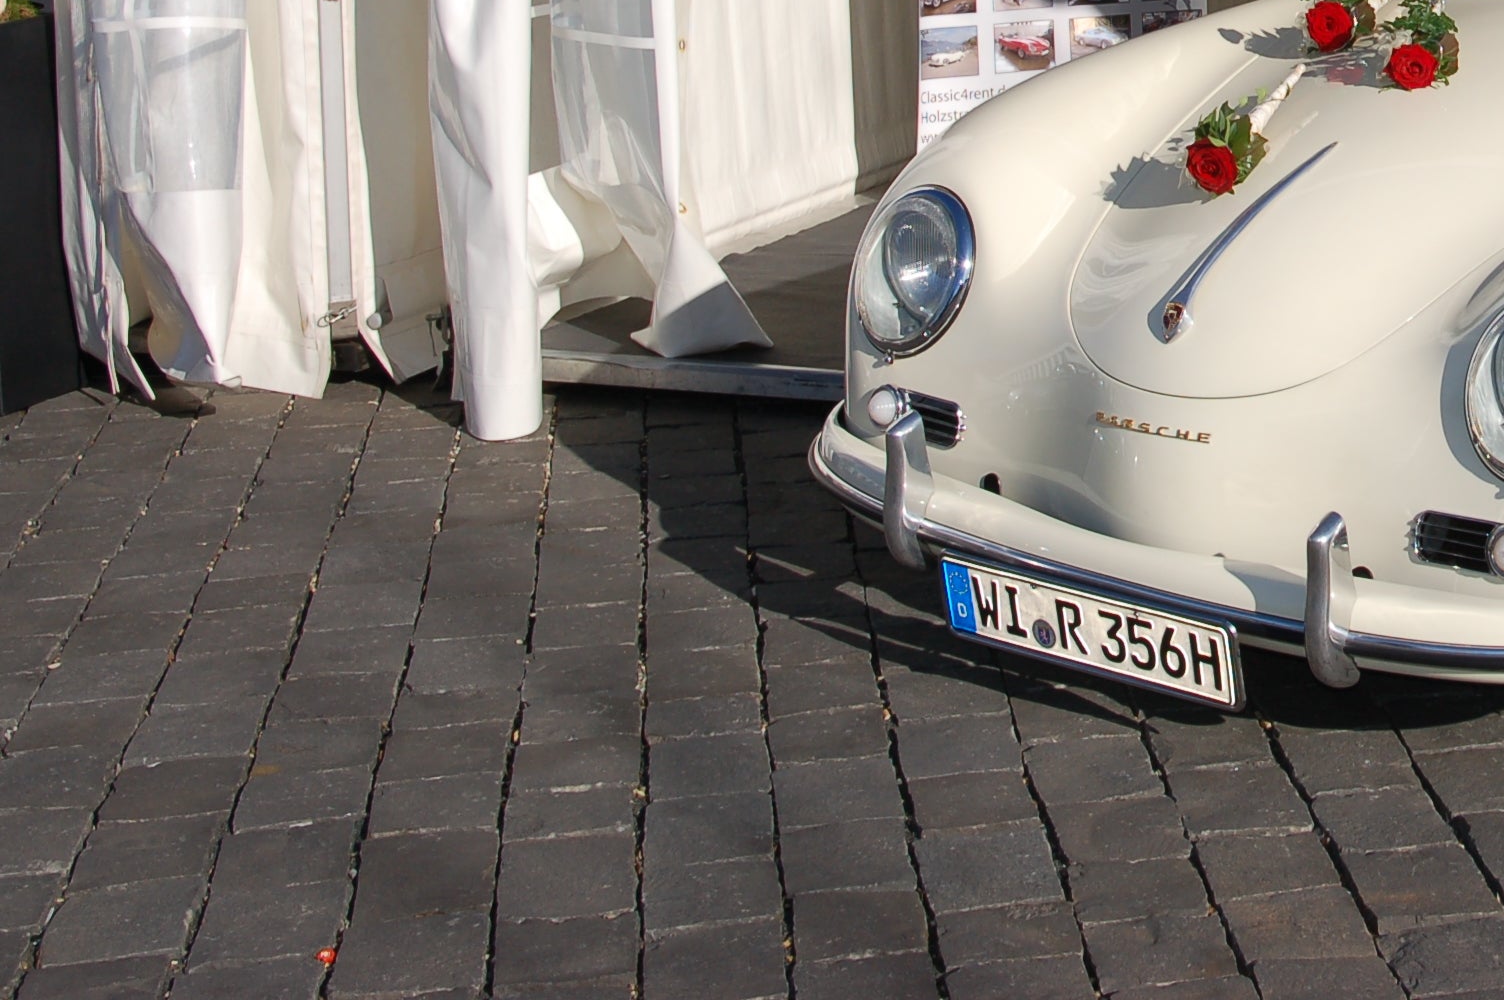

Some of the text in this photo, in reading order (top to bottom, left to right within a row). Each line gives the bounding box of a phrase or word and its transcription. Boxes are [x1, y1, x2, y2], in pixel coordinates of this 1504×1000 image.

[921, 110, 969, 124] Holzstr
[972, 575, 1223, 692] WI R 356H
